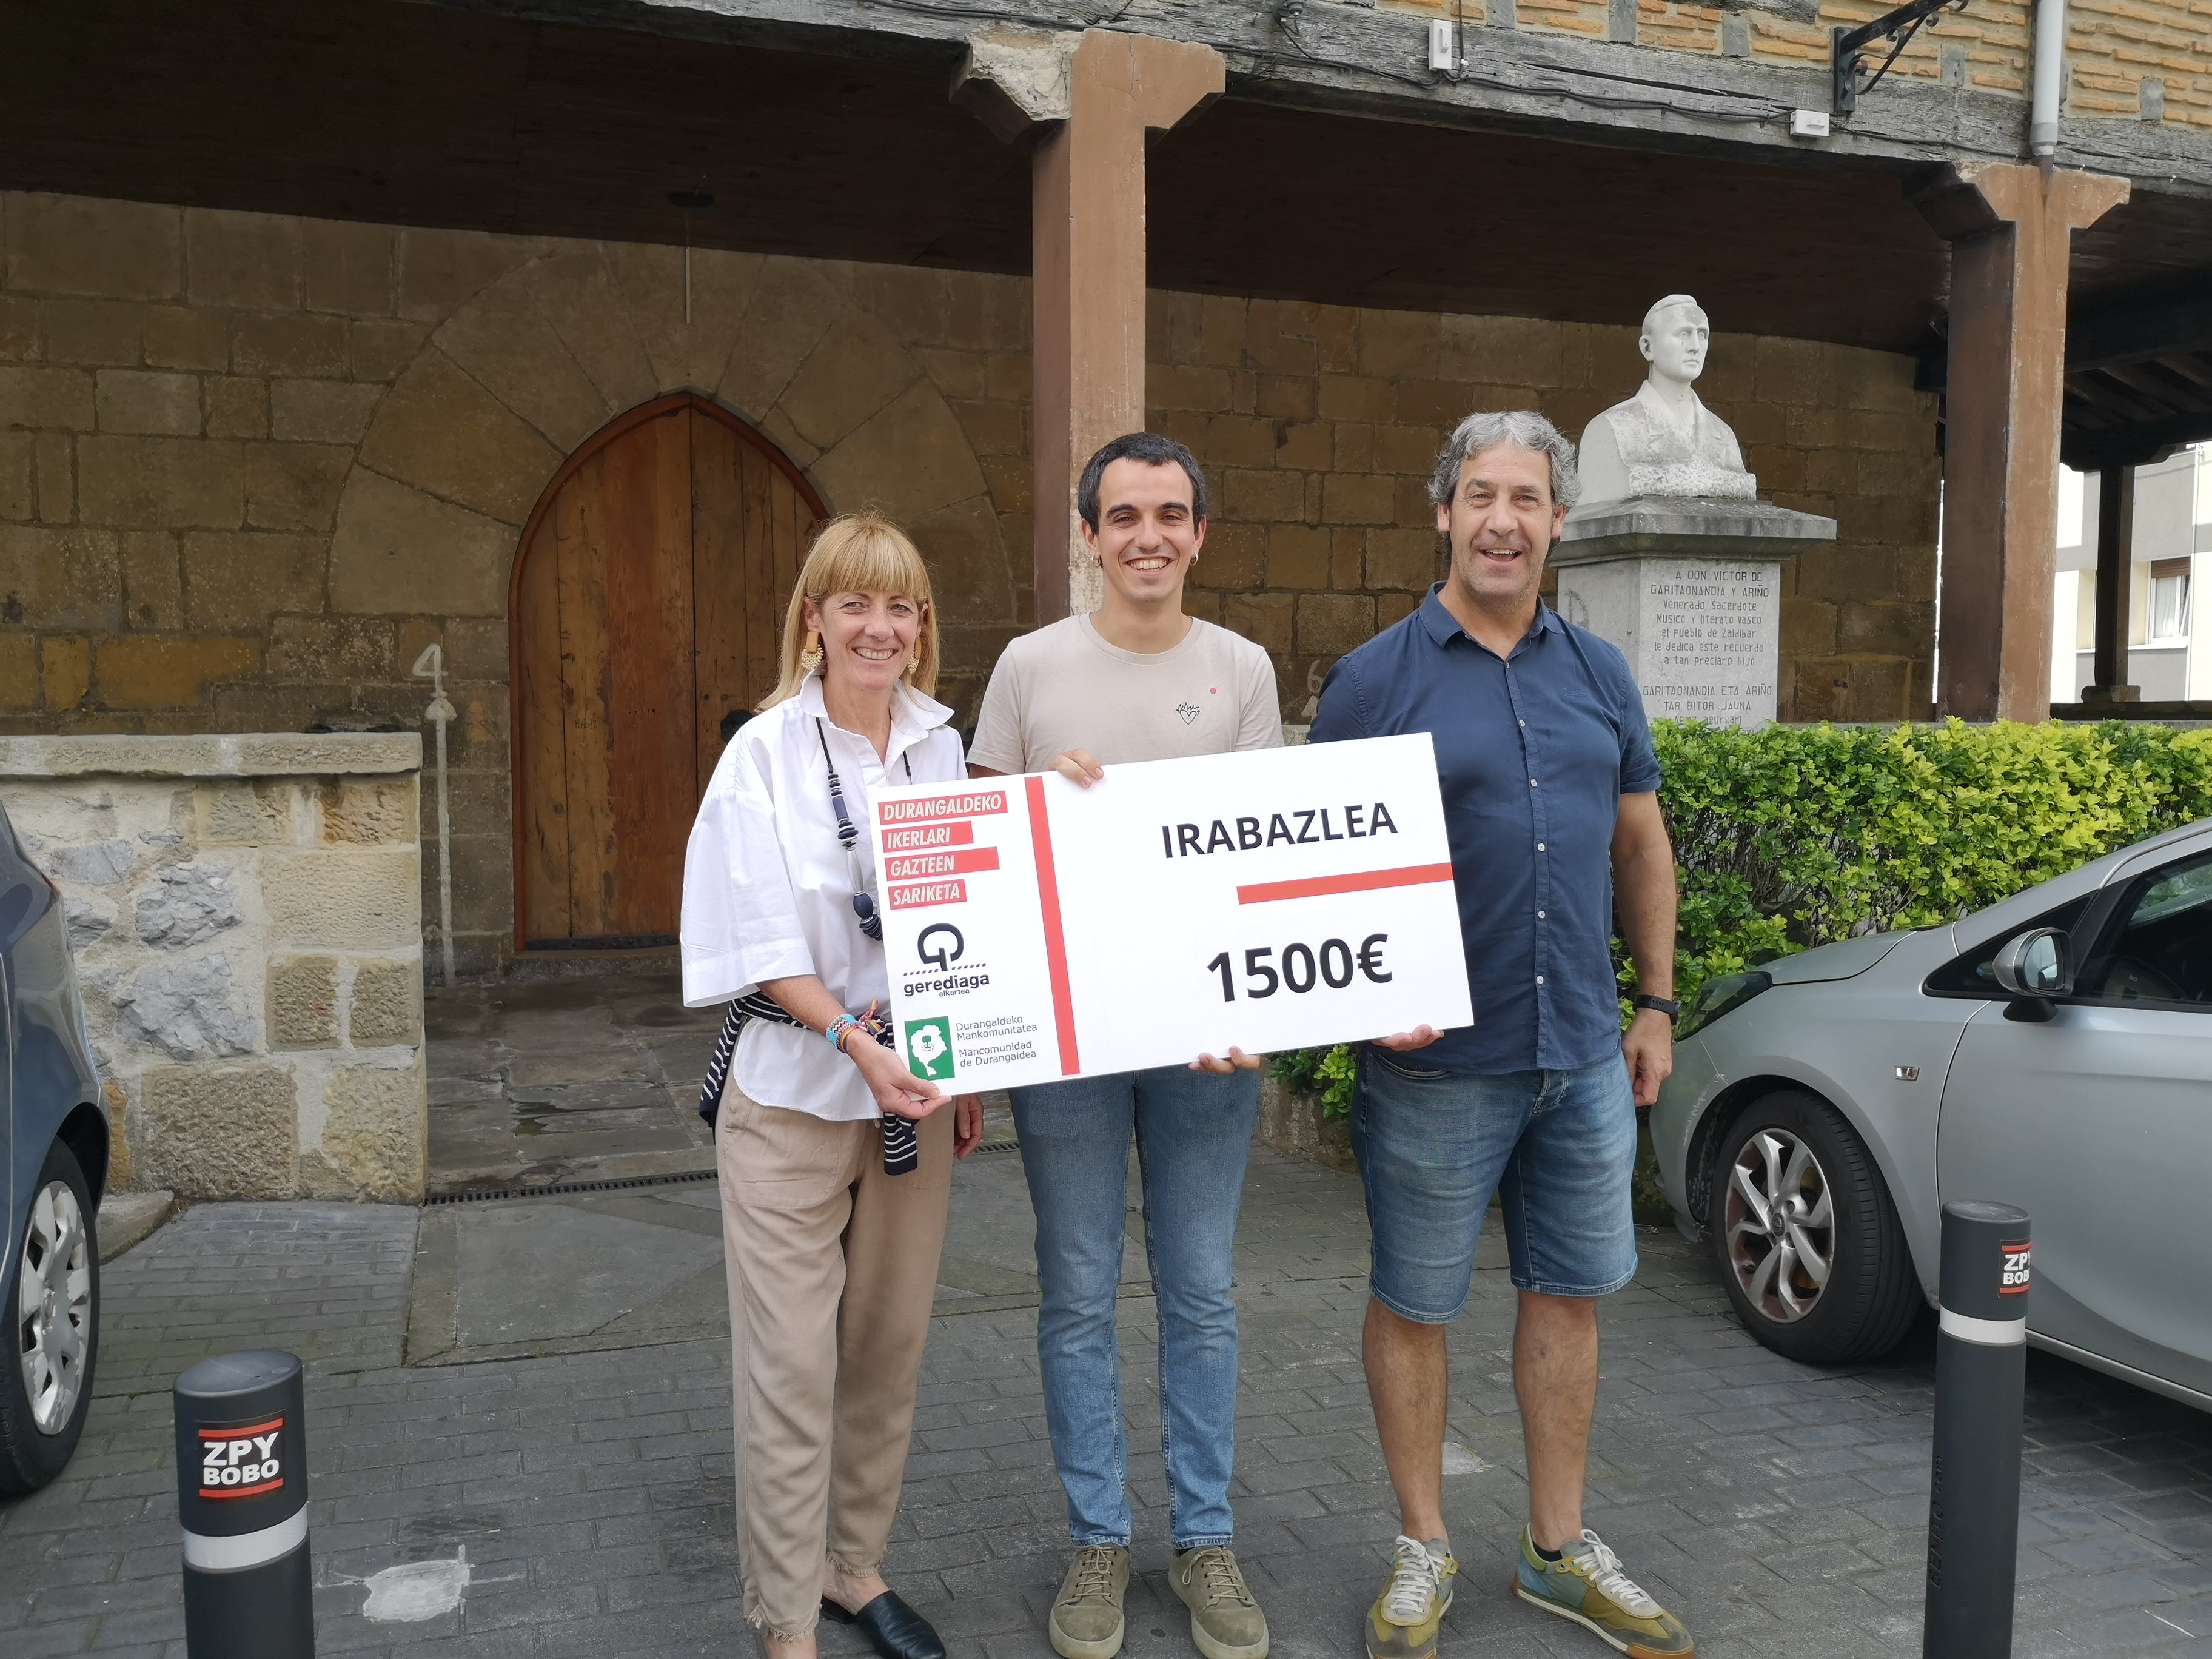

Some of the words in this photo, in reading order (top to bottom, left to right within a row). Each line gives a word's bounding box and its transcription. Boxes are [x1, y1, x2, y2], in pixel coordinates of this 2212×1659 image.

[1675, 570, 1681, 580] A
[1687, 570, 1707, 580] DON
[1714, 571, 1747, 581] VICTOR
[1751, 572, 1761, 581] DE
[1651, 585, 1725, 597] GARITAONANDIA
[1731, 587, 1736, 597] Y
[1742, 585, 1769, 597] ARIÑO
[1663, 599, 1705, 610] Venerado
[1712, 600, 1757, 611] Sacerdote
[1657, 613, 1685, 623] Musico
[1700, 614, 1734, 624] literato
[1738, 615, 1761, 625] vasco
[1661, 628, 1669, 637] el
[1674, 628, 1702, 638] pueblo
[1707, 628, 1717, 638] de
[1721, 628, 1757, 638] Zaldibar
[1654, 642, 1661, 651] le
[1666, 642, 1694, 651] dedica
[1699, 643, 1718, 652] este
[1724, 643, 1763, 652] recuerdo
[412, 643, 448, 691] 4
[1664, 656, 1669, 665] a
[1674, 655, 1689, 665] tan
[1694, 656, 1732, 666] preclaro
[1737, 656, 1755, 666] hijo
[1643, 686, 1715, 696] GARITAONANDIA
[1721, 686, 1739, 695] ETA
[1746, 683, 1772, 695] ARIÑO
[1664, 701, 1680, 711] TAR
[1687, 701, 1714, 711] BITOR
[1721, 701, 1751, 711] JAUNA
[883, 794, 1002, 821] DURANGALDEKO
[887, 826, 950, 849] IKERLARI
[1162, 802, 1398, 858] IRABAZLEA
[890, 855, 956, 877] GAZTEEN
[893, 883, 960, 905] SARIKETA
[1207, 933, 1393, 1002] 1500€
[903, 974, 990, 997] gerediaga
[939, 988, 970, 997] elkartea
[956, 1015, 1024, 1031] Durangaldeko
[957, 1024, 1037, 1041] Mankomunitatea
[959, 1040, 1032, 1057] Mancomunidad
[960, 1057, 972, 1067] de
[976, 1050, 1037, 1065] Durangaldea
[2003, 1267, 2030, 1284] BOB
[203, 1432, 280, 1466] ZPY
[203, 1459, 280, 1486] BOBO
